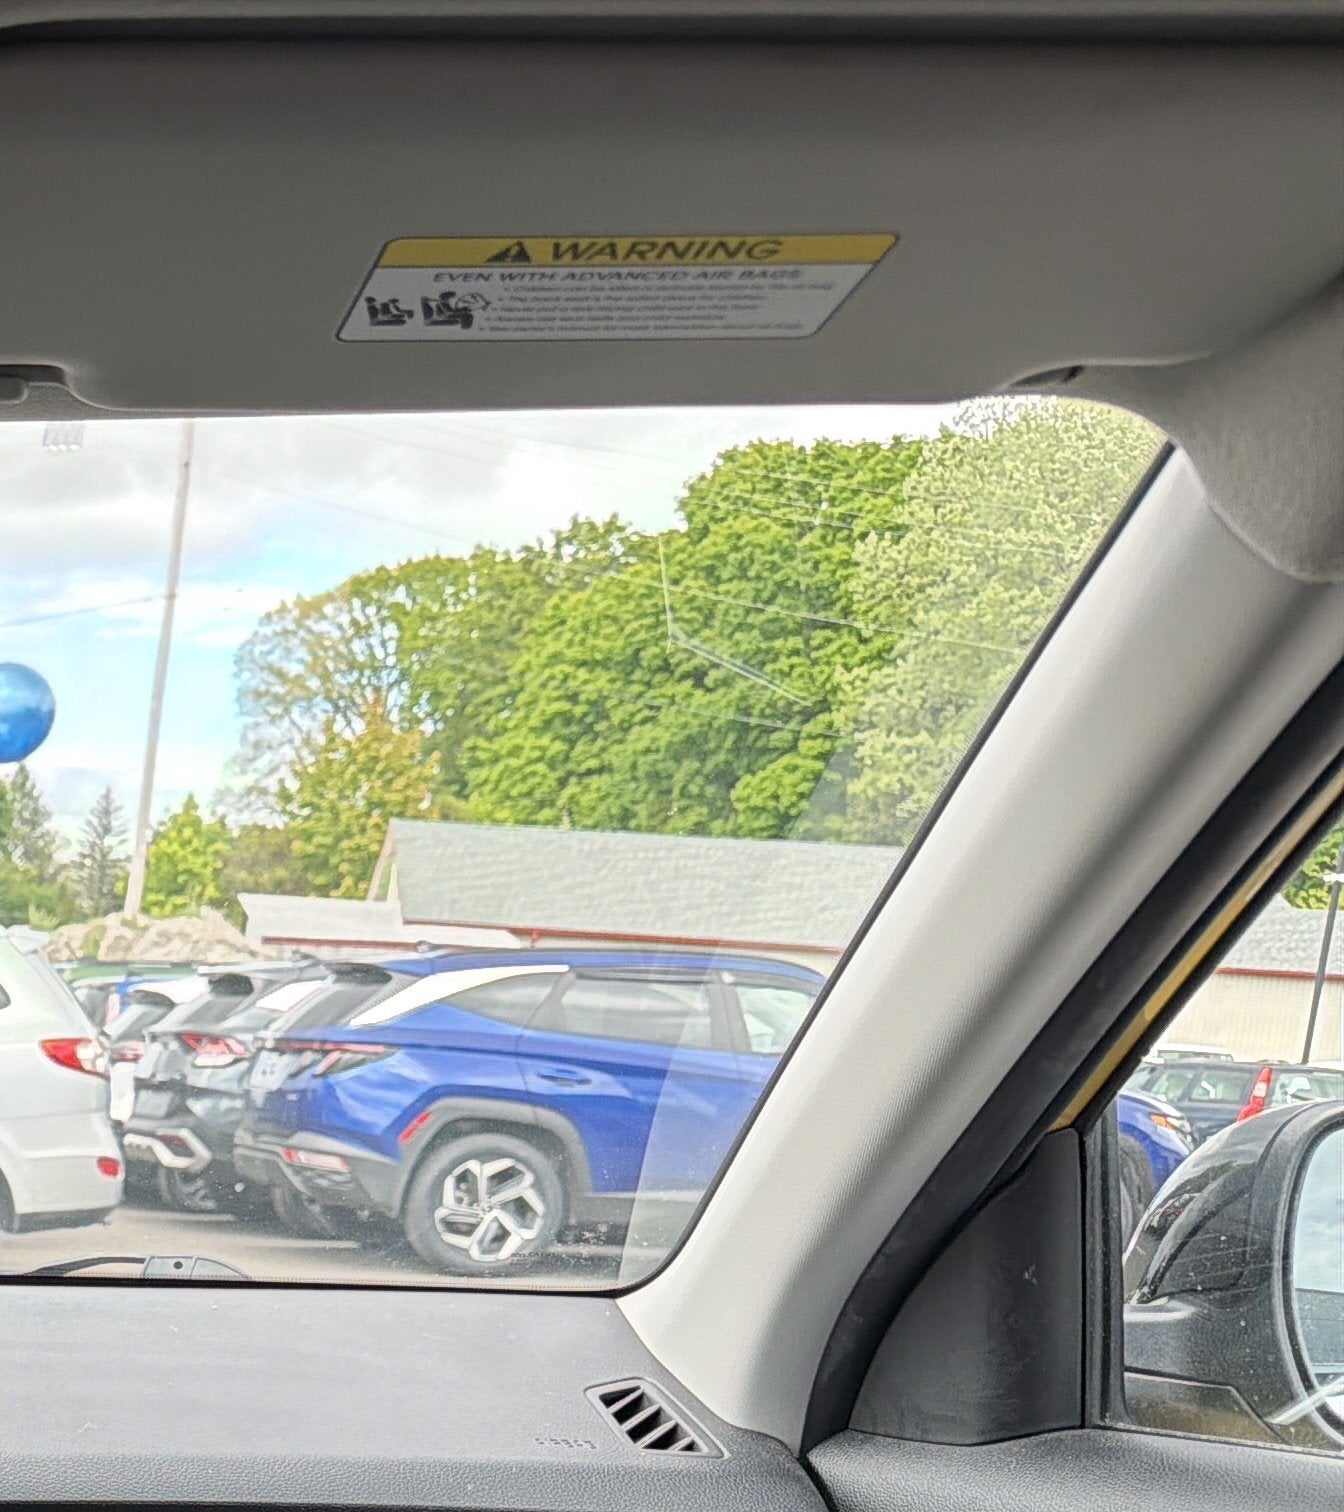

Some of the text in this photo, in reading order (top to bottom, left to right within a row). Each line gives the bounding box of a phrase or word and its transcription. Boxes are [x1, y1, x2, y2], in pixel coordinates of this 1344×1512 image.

[551, 240, 783, 261] WARNING
[432, 270, 801, 283] EVEN WITH ADVANCED AIR BAGS
